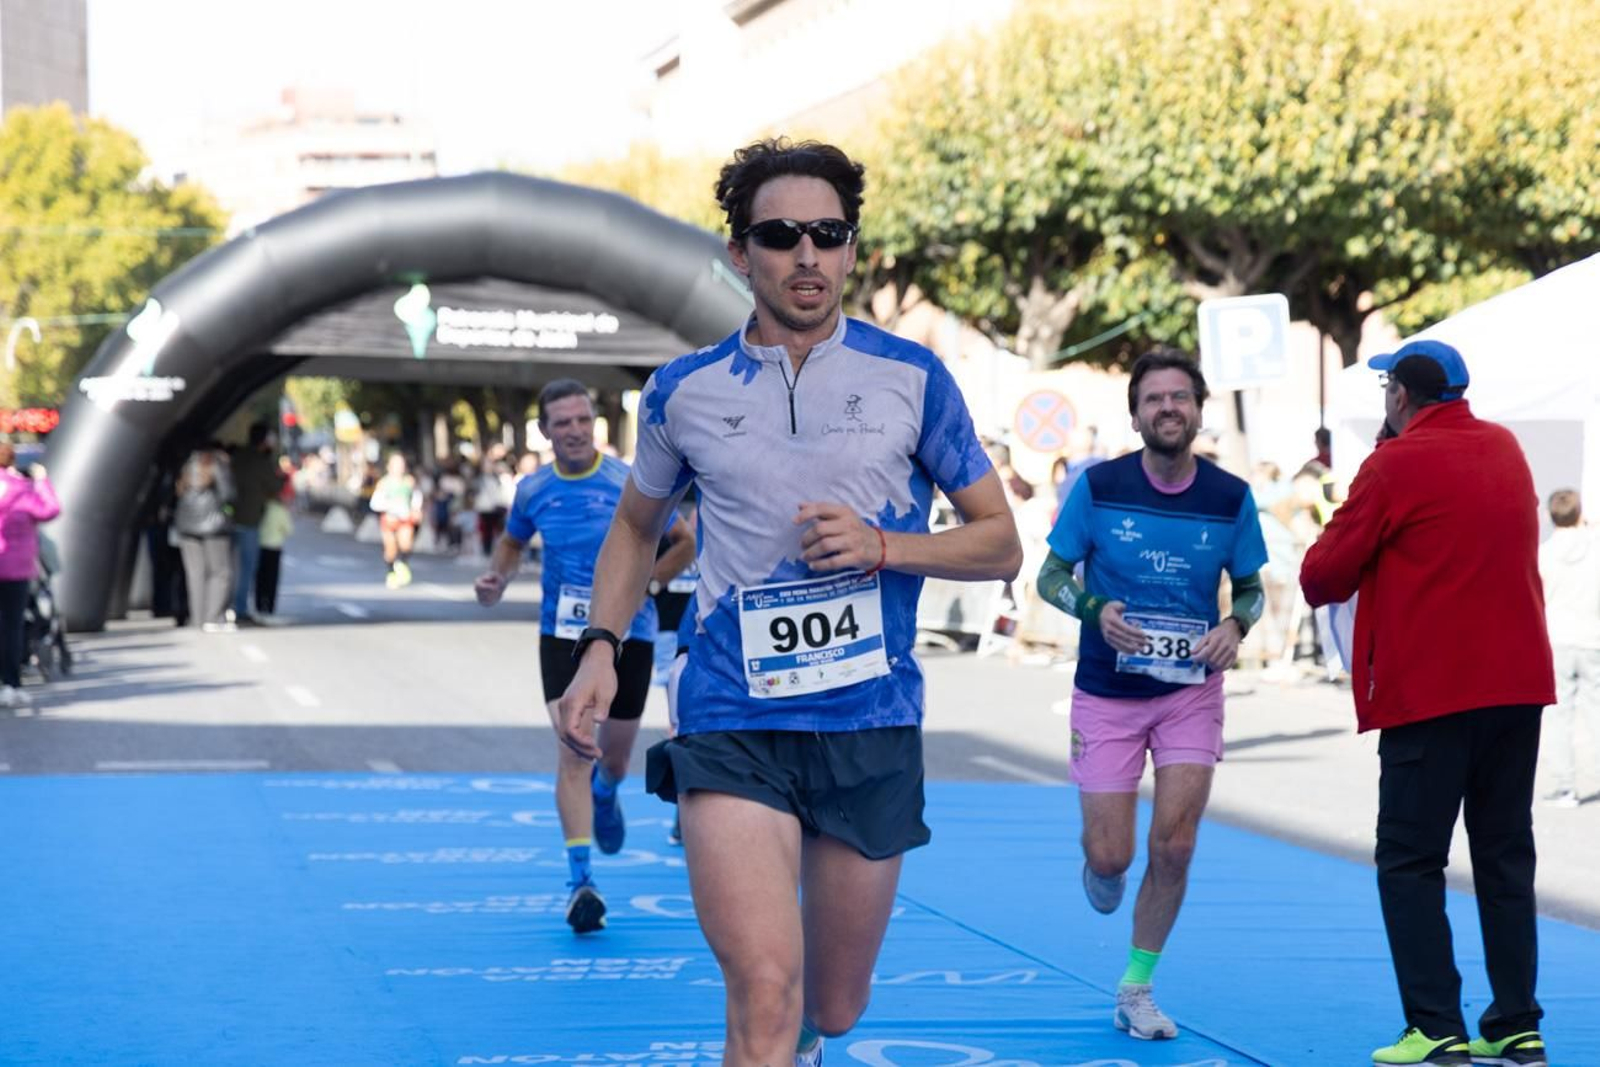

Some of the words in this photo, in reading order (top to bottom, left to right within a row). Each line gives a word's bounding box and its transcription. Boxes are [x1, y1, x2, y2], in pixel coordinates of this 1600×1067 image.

[1219, 309, 1272, 379] P
[769, 603, 859, 653] 904
[796, 648, 845, 664] FRANCISCO
